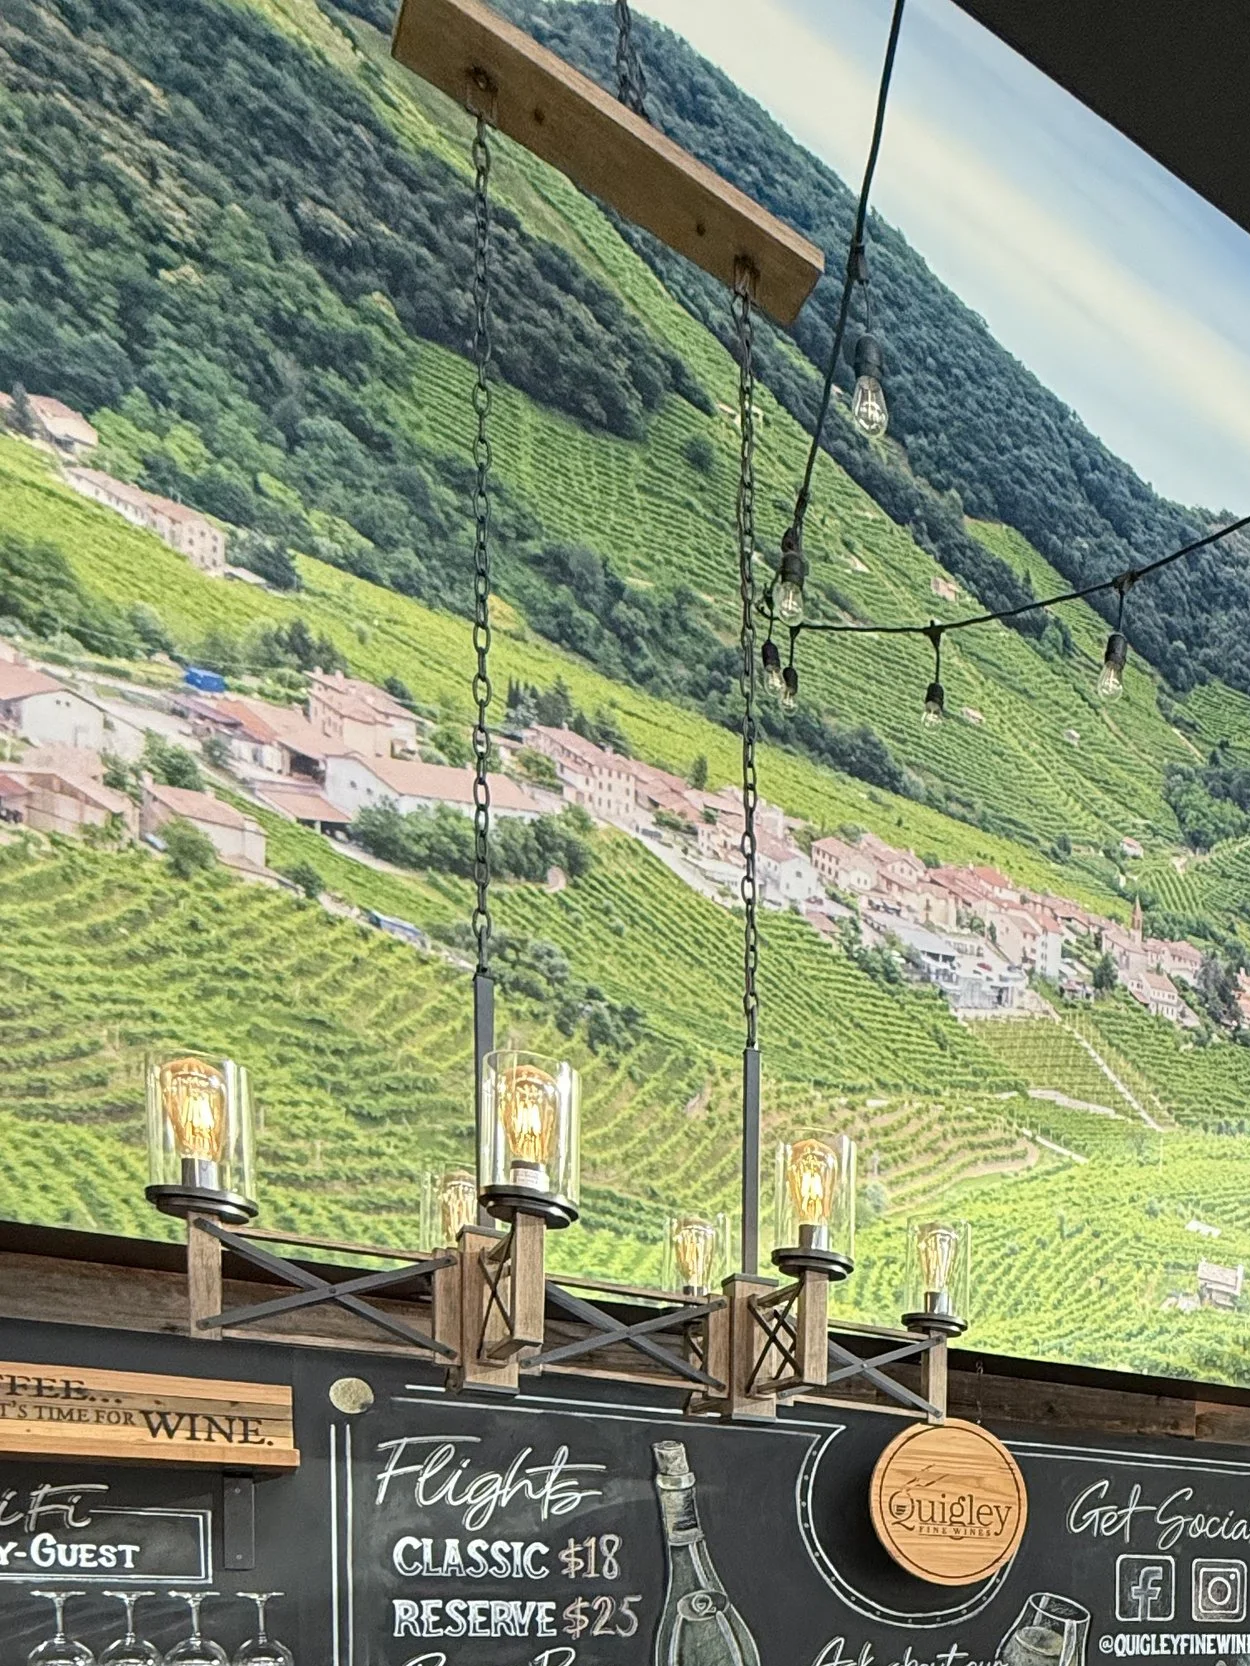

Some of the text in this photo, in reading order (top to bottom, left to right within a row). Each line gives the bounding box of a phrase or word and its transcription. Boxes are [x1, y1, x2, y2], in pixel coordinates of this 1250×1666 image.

[35, 1405, 90, 1423] TIME
[94, 1409, 136, 1426] FOR
[140, 1409, 275, 1446] WINE.
[375, 1435, 607, 1531] Flights
[888, 1489, 1013, 1540] Quigley
[919, 1525, 992, 1537] FINE WINES
[1066, 1479, 1157, 1543] Get
[393, 1534, 623, 1580] CLASSIC $18
[392, 1594, 643, 1640] RESERVE $25
